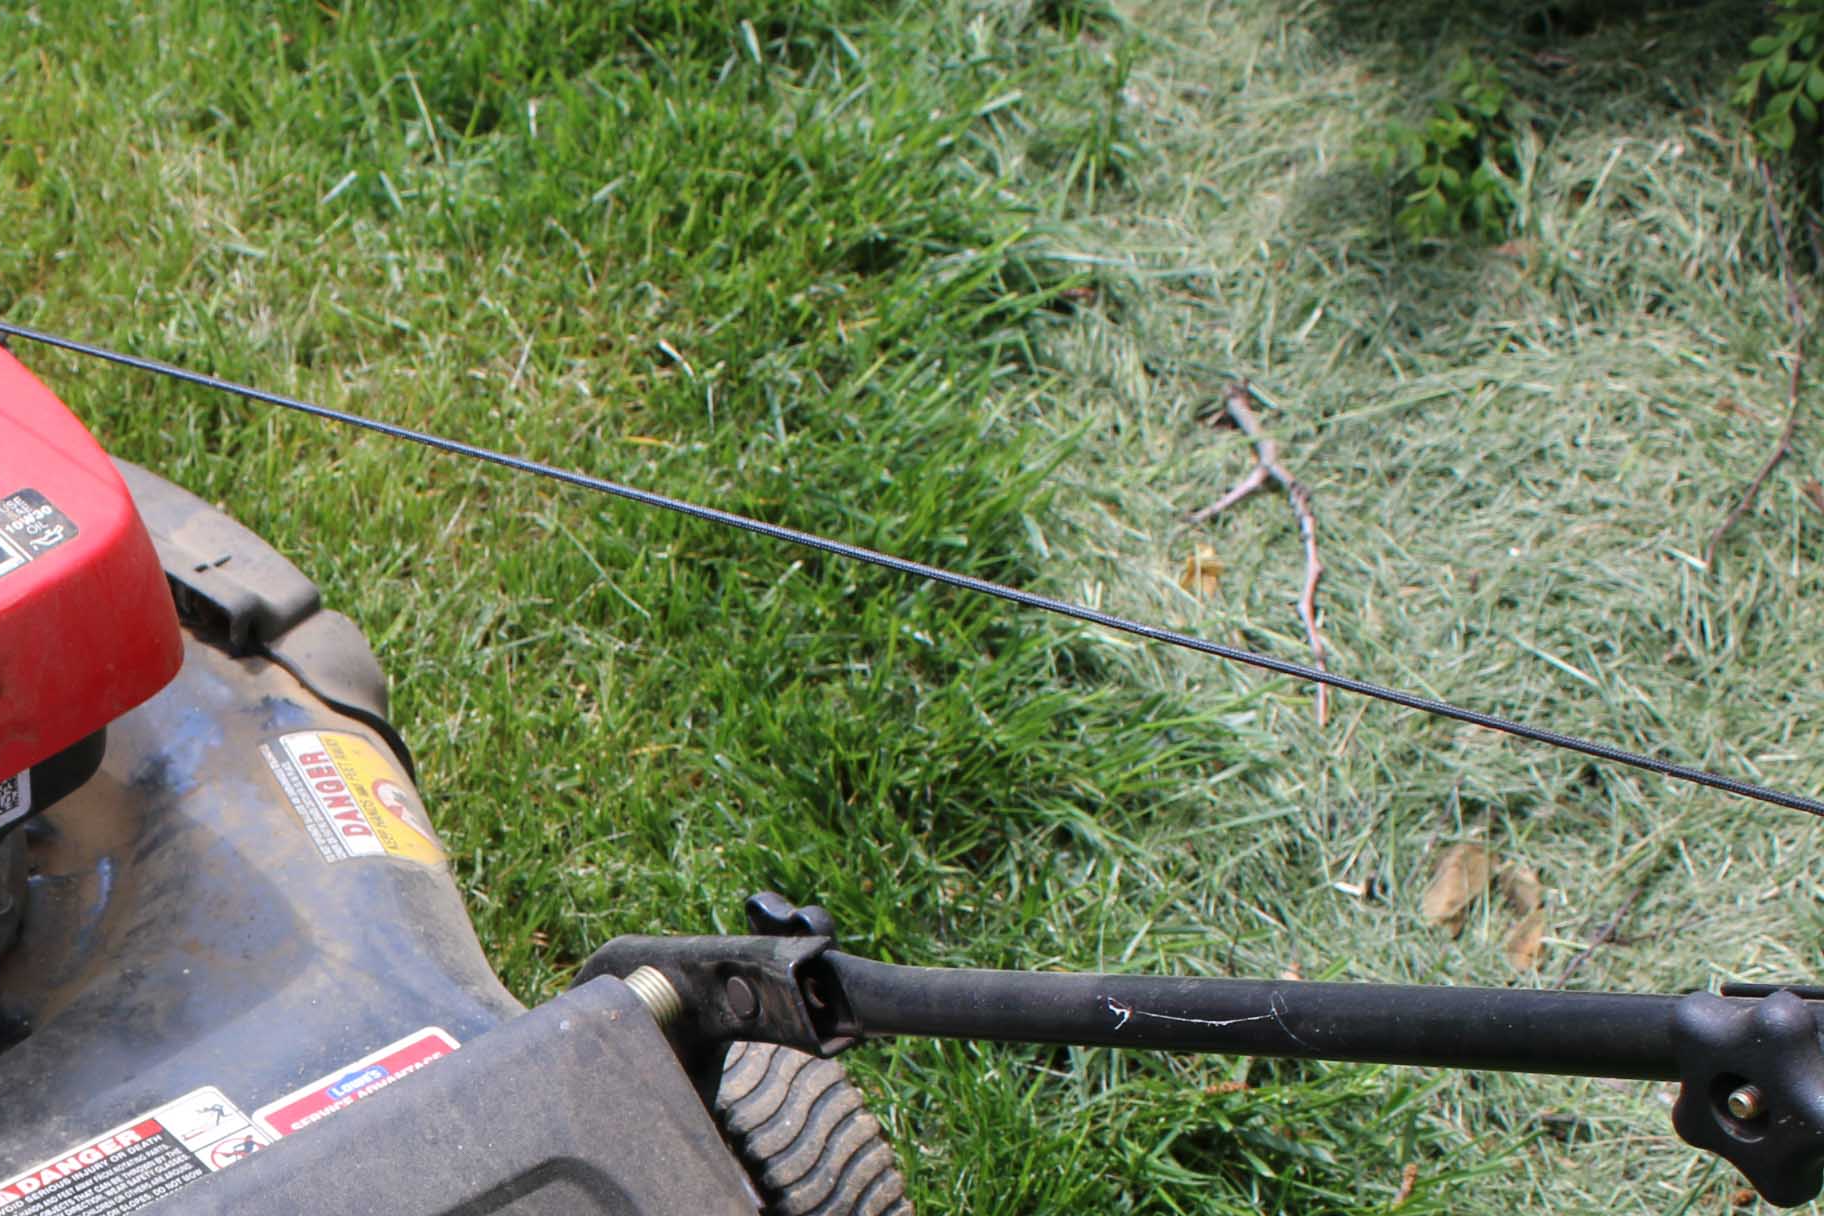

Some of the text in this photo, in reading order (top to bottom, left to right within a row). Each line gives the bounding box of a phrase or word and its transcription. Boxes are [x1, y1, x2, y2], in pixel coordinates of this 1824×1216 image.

[3, 503, 54, 535] 10W30
[24, 518, 50, 535] OIL
[298, 751, 372, 837] DANGER
[21, 1129, 143, 1191] DANGER
[22, 1177, 72, 1203] SERIOUS
[70, 1159, 110, 1181] INJURY
[107, 1151, 128, 1163] OR
[125, 1134, 164, 1155] DEATH
[73, 1189, 95, 1202] THAT
[92, 1180, 112, 1193] CAN
[109, 1175, 123, 1184] BE
[121, 1159, 157, 1179] THROWN
[153, 1154, 167, 1164] BY
[164, 1147, 182, 1159] THE
[41, 1195, 59, 1206] AND
[56, 1187, 76, 1199] FEET
[73, 1178, 95, 1191] AWAY
[92, 1169, 115, 1182] FROM
[104, 1182, 128, 1196] WEAR
[125, 1169, 156, 1186] SAFETY
[105, 1207, 121, 1216] ON
[151, 1185, 167, 1196] DO
[164, 1177, 183, 1189] NOT
[113, 1194, 126, 1203] OR
[123, 1182, 152, 1198] OTHERS
[149, 1175, 166, 1186] ARE
